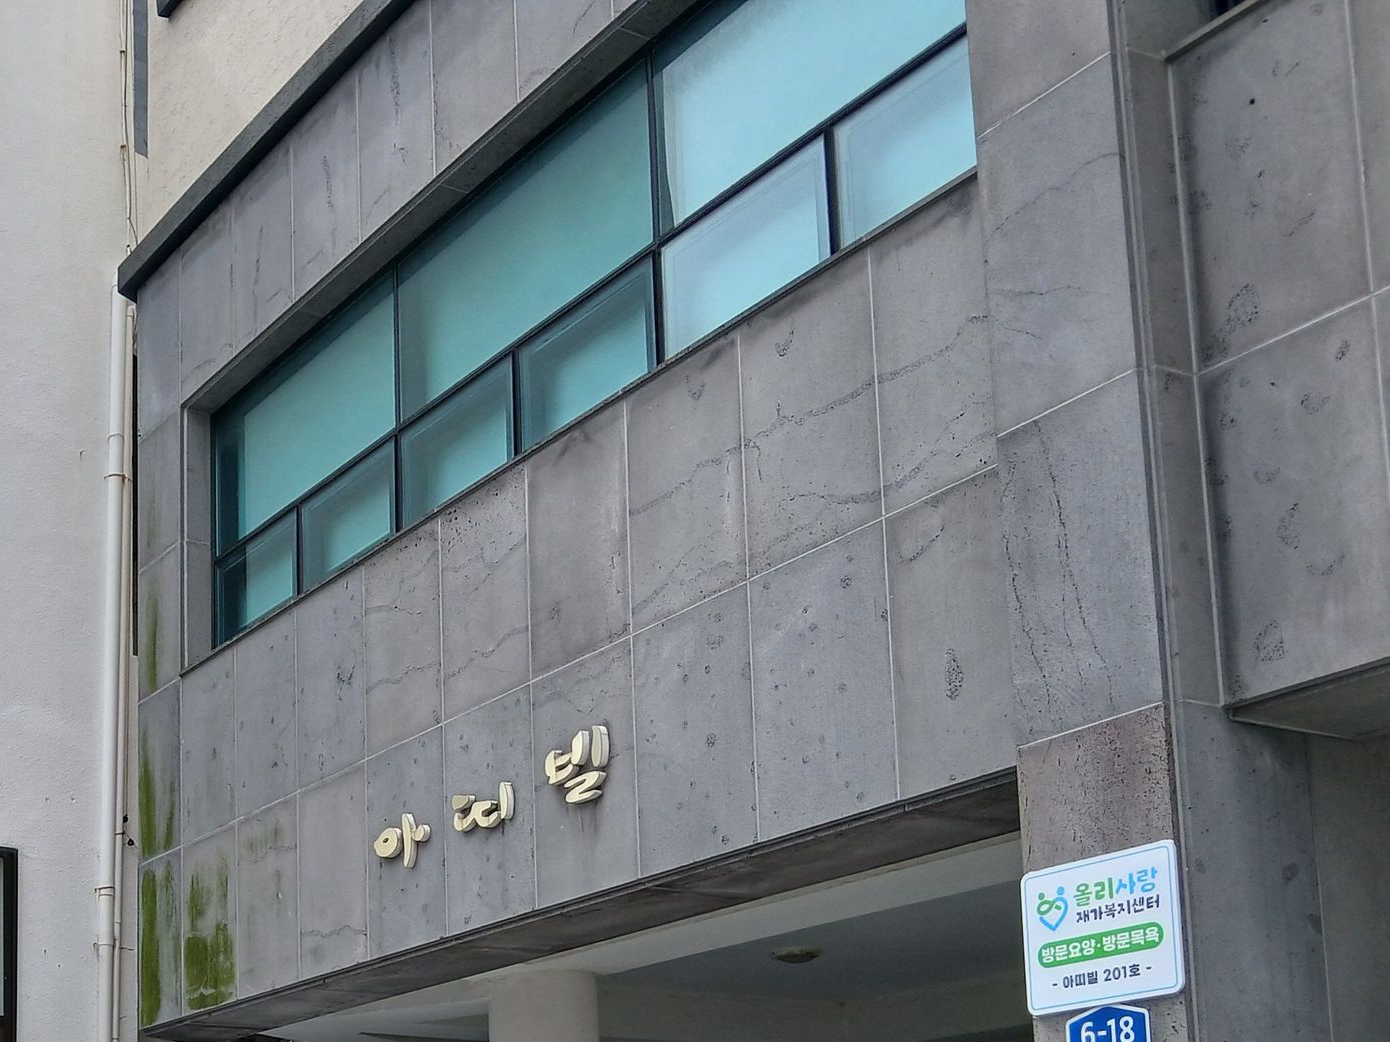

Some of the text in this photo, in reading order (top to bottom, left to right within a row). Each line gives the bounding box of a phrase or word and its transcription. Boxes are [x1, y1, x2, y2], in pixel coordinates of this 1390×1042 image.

[1073, 867, 1158, 907] 올리사랑
[1076, 894, 1160, 924] 재가복지센터
[1063, 963, 1141, 989] 아띠빌 201호
